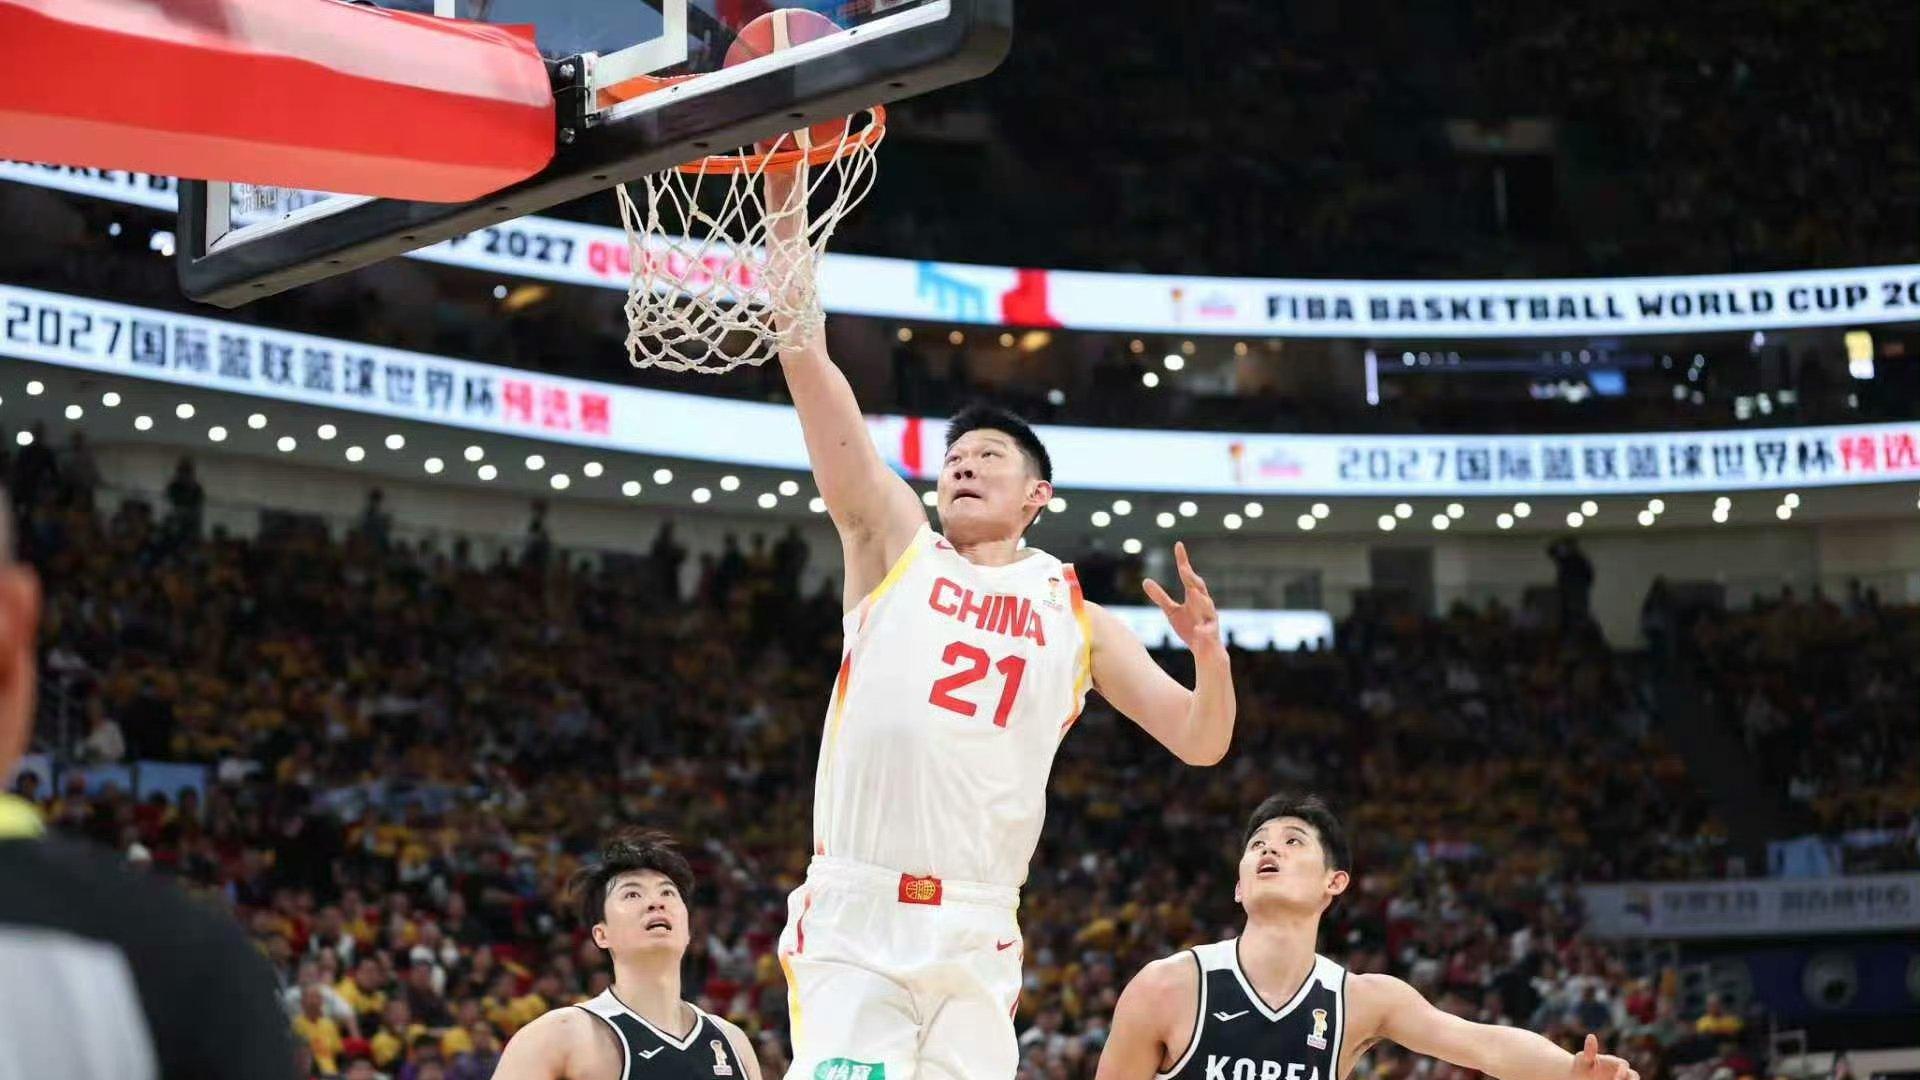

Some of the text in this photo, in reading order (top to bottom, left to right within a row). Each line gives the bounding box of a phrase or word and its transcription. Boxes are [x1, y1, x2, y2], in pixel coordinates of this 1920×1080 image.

[482, 227, 574, 264] 2027
[1266, 295, 1354, 320] FIBA
[1368, 293, 1621, 321] BASKETBALL
[1637, 287, 1775, 318] WORLD
[1786, 284, 1867, 313] CUP
[928, 576, 1046, 646] CHINA
[928, 641, 1026, 728] 21
